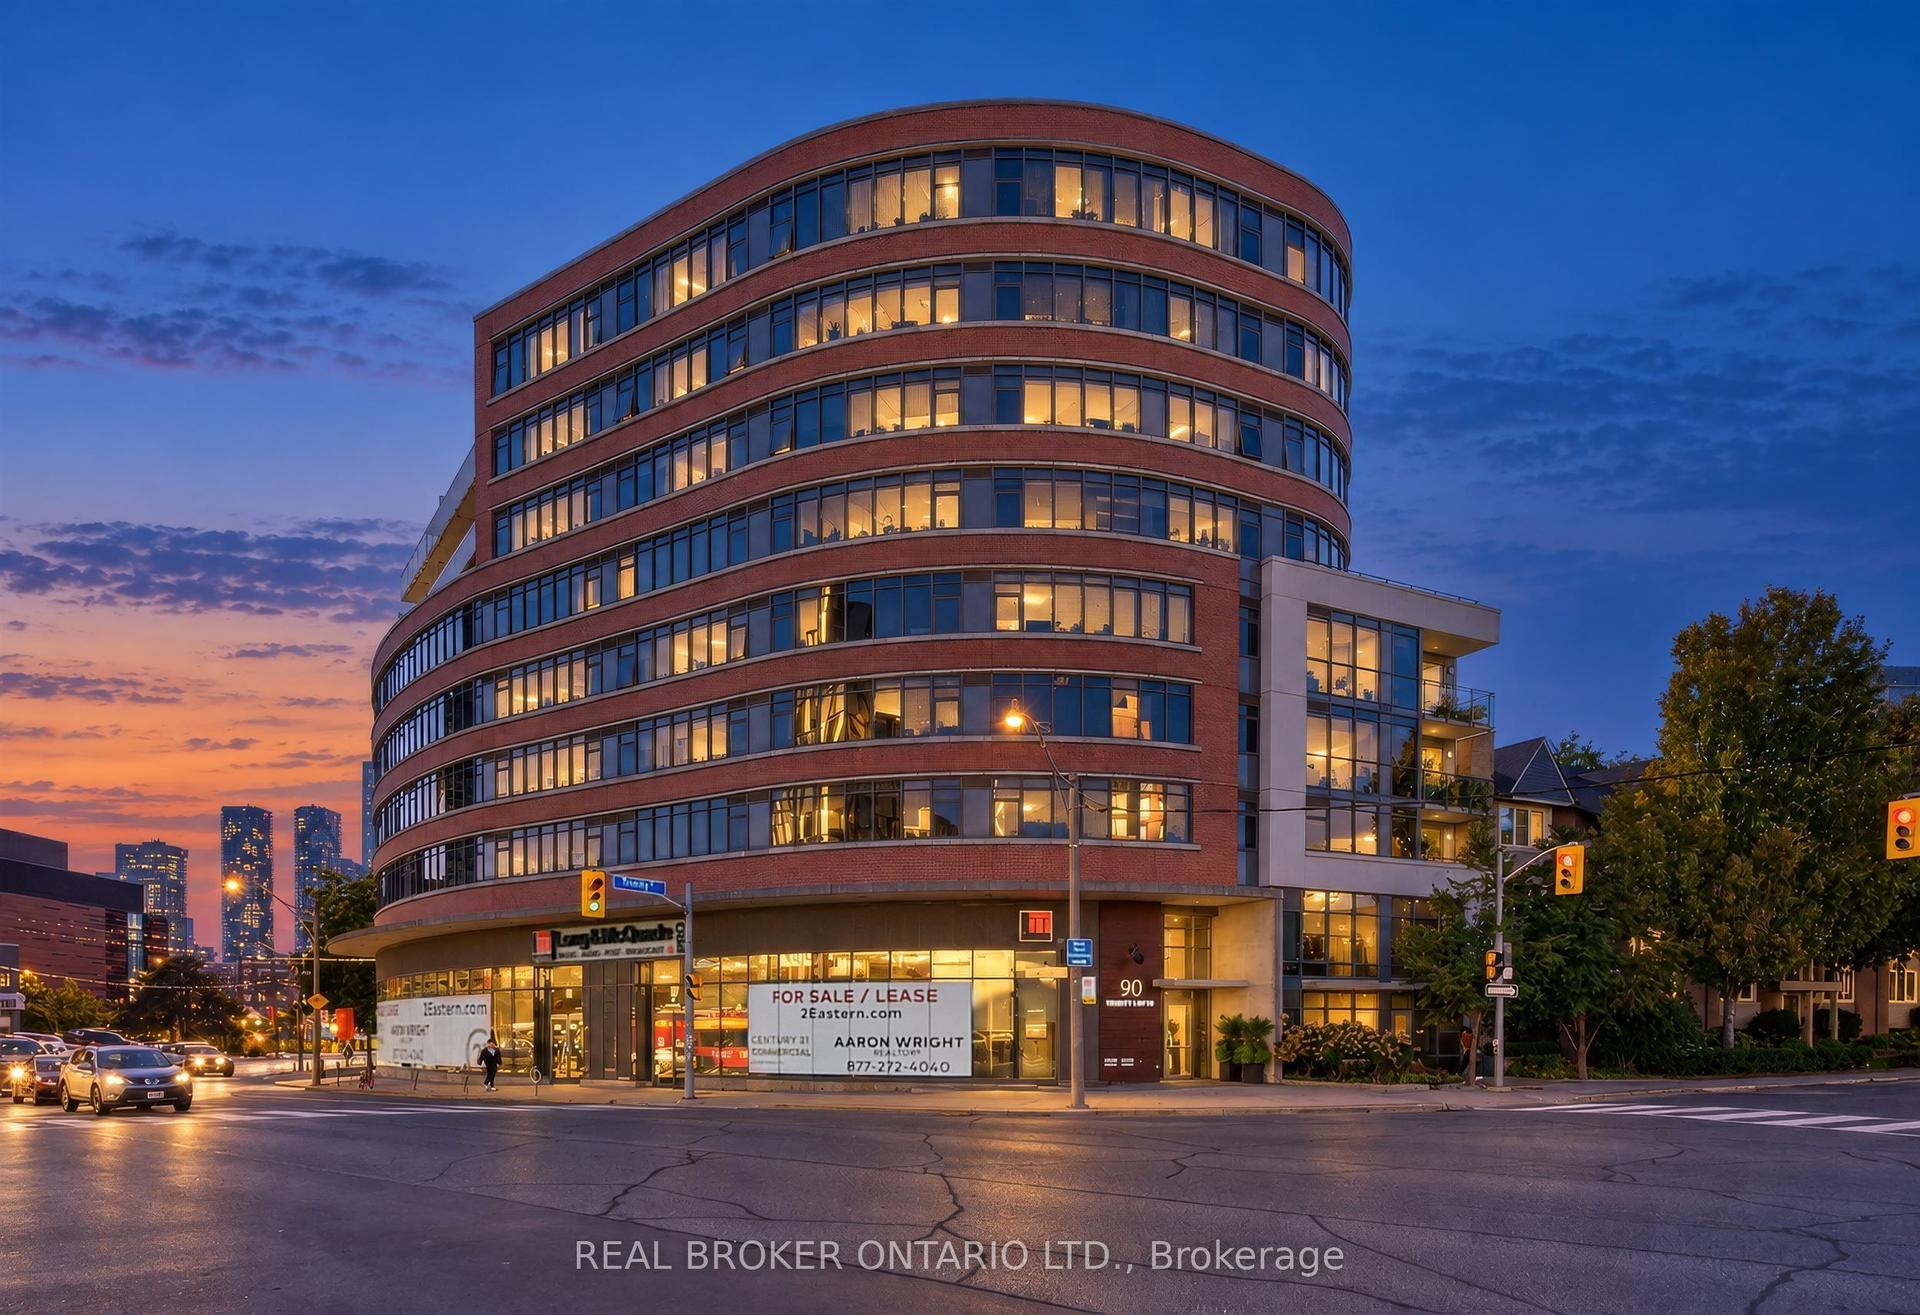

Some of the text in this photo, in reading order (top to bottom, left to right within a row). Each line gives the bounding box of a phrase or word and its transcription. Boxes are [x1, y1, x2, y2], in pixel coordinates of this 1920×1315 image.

[1120, 979, 1142, 997] 90
[772, 988, 938, 1004] FOR SALE / LEASE
[800, 1007, 902, 1019] 2Eastern.com
[751, 1035, 797, 1045] CENTURY
[834, 1036, 964, 1048] AARON WRIGHT
[847, 1060, 950, 1073] 877-272-4040
